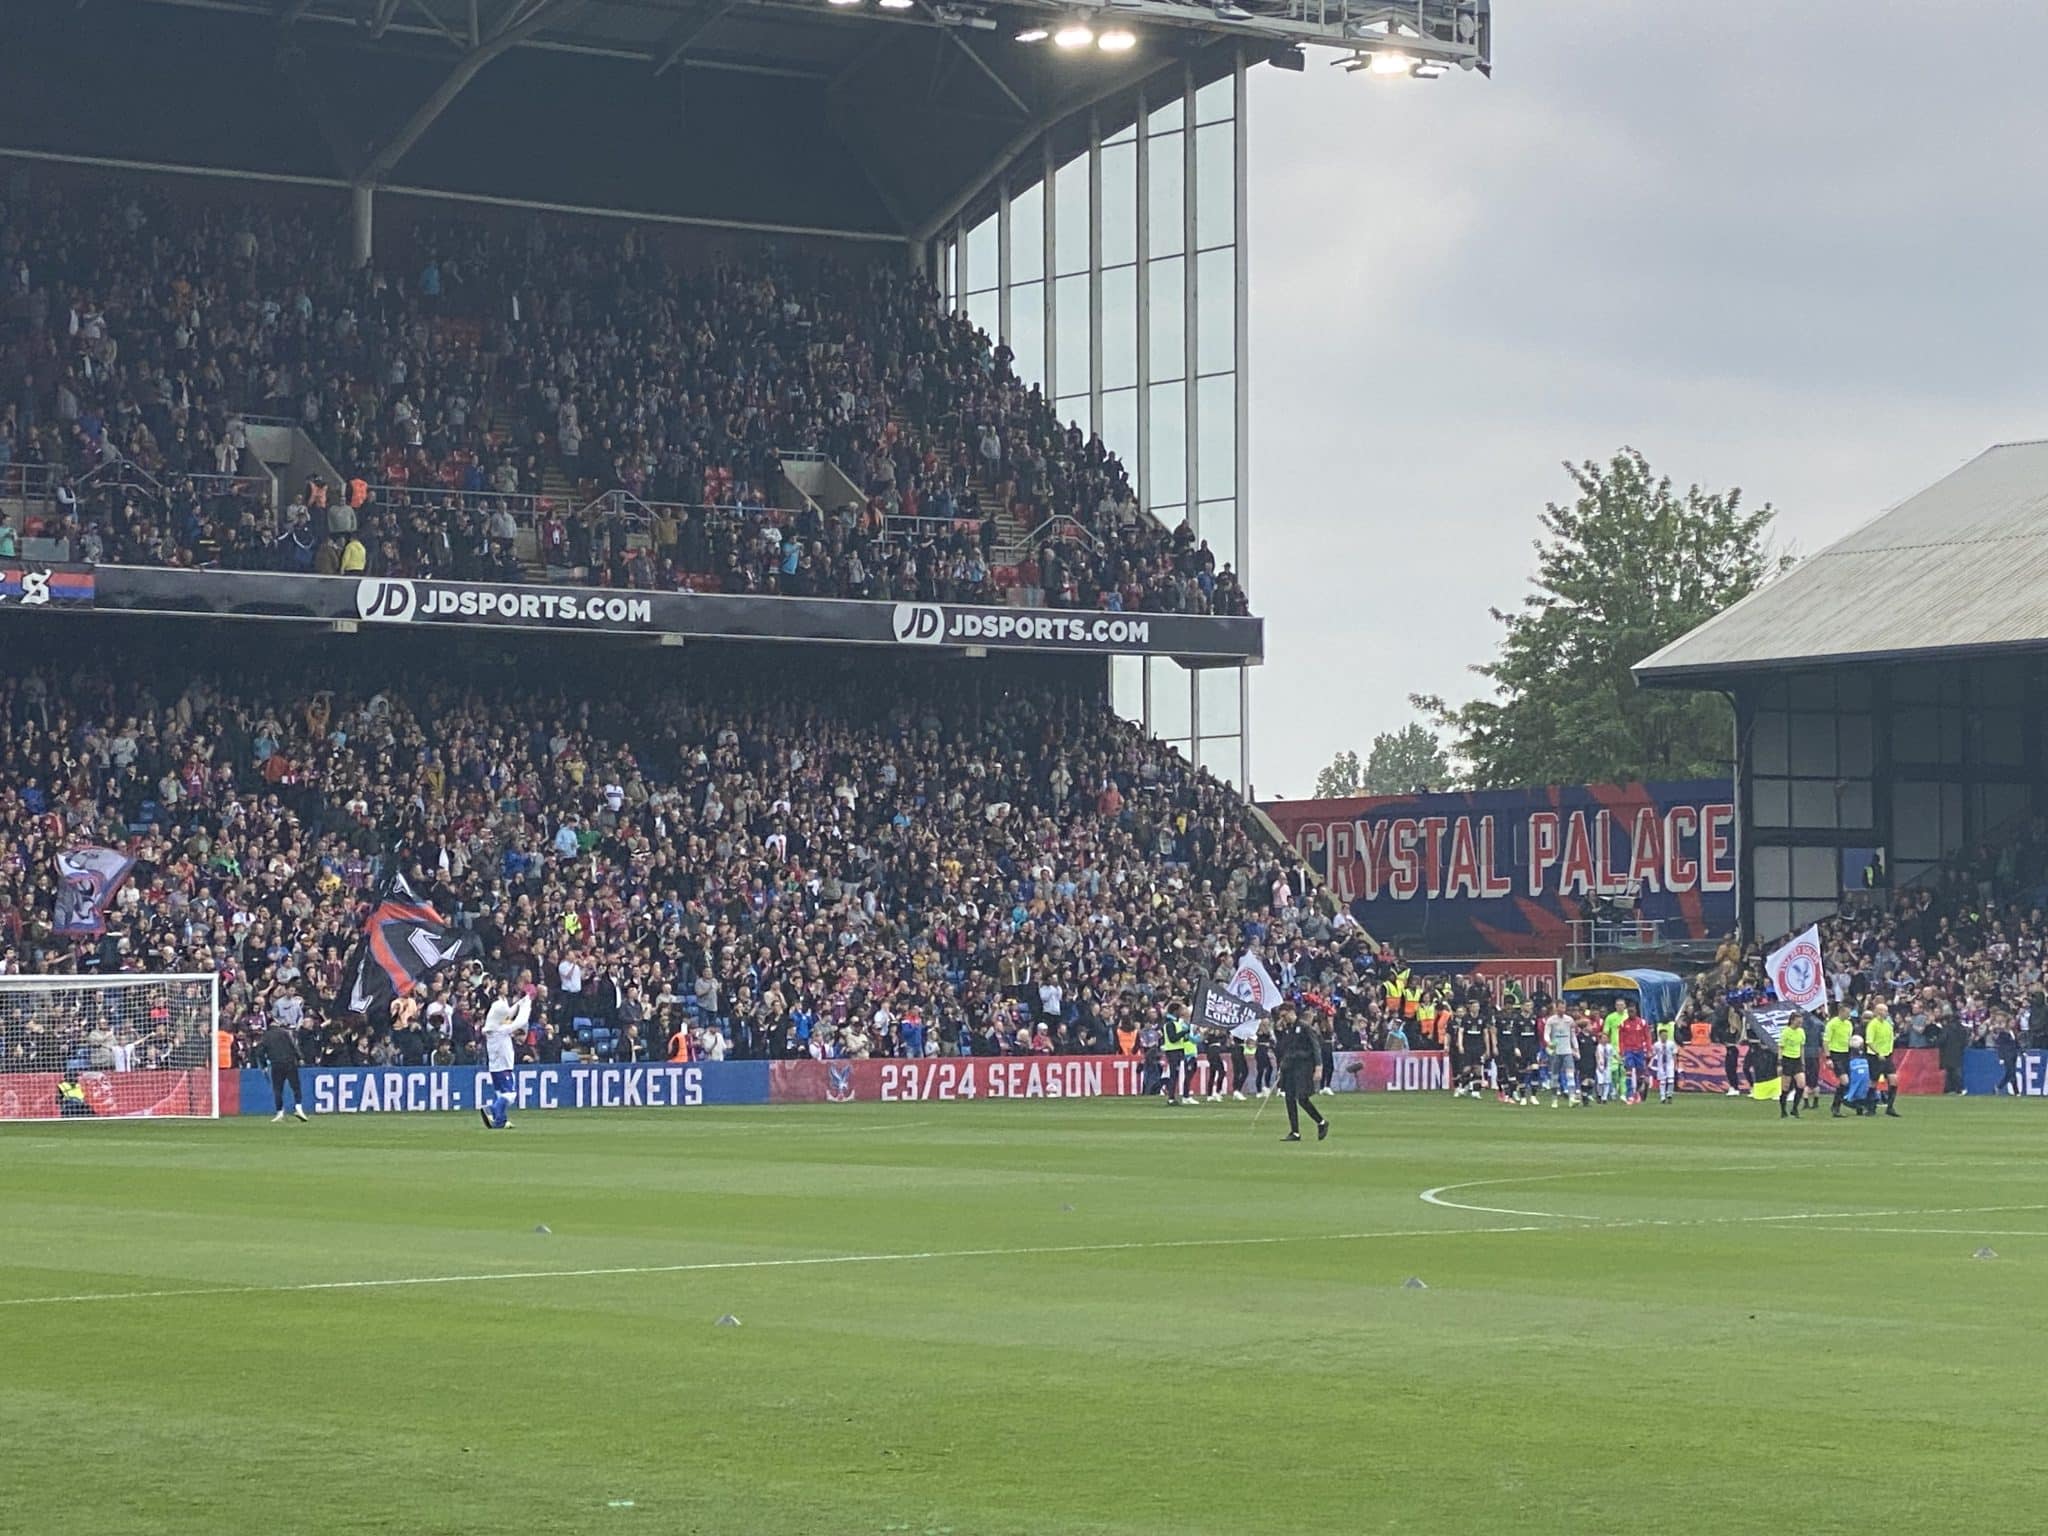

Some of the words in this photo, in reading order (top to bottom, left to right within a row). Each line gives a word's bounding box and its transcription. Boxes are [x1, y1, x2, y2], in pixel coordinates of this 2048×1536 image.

[366, 583, 410, 616] JD
[421, 590, 651, 623] JDSPORTS.COM
[901, 607, 938, 639] JD
[949, 614, 1149, 643] JDSPORTS.COM
[1296, 816, 1511, 902] CRYSTAL
[1528, 804, 1735, 896] PALACE
[314, 1072, 460, 1112] SEARCH:
[475, 1070, 558, 1109] CFC
[571, 1067, 702, 1107] TICKETS
[881, 1062, 977, 1101] 23/24
[988, 1061, 1102, 1098] SEASON
[1386, 1055, 1450, 1091] JOIN
